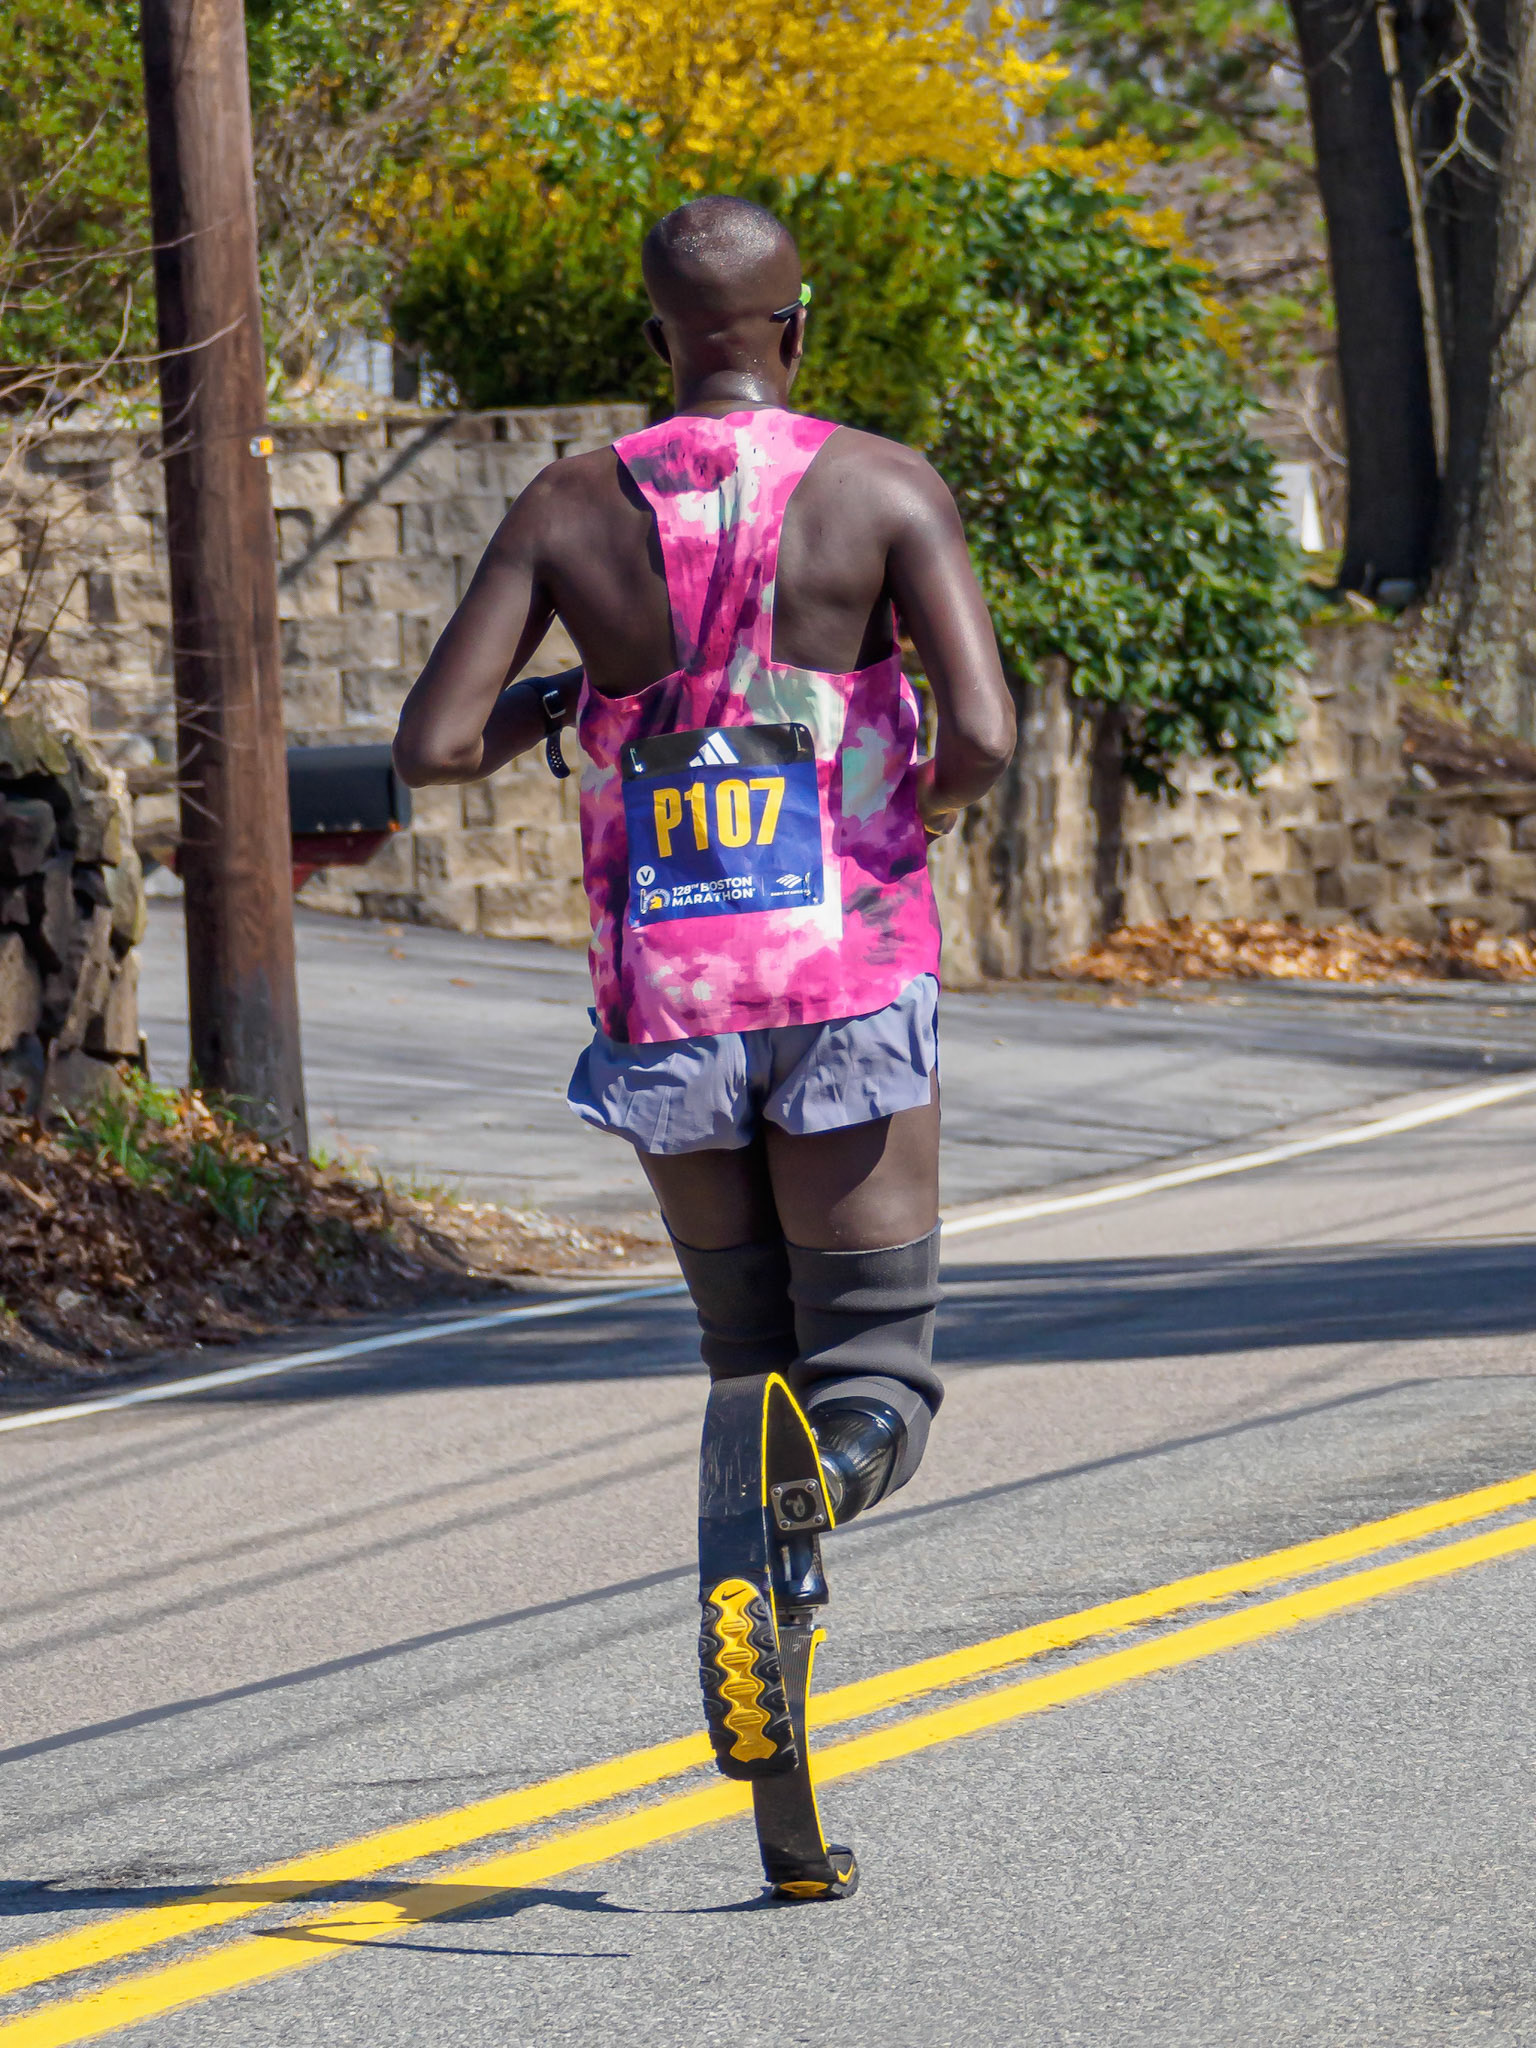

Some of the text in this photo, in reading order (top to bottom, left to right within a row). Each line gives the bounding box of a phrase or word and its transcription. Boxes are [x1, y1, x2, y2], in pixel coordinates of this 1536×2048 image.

[653, 777, 785, 858] P107
[700, 876, 752, 893] BOSTON
[672, 887, 754, 907] MARATHON
